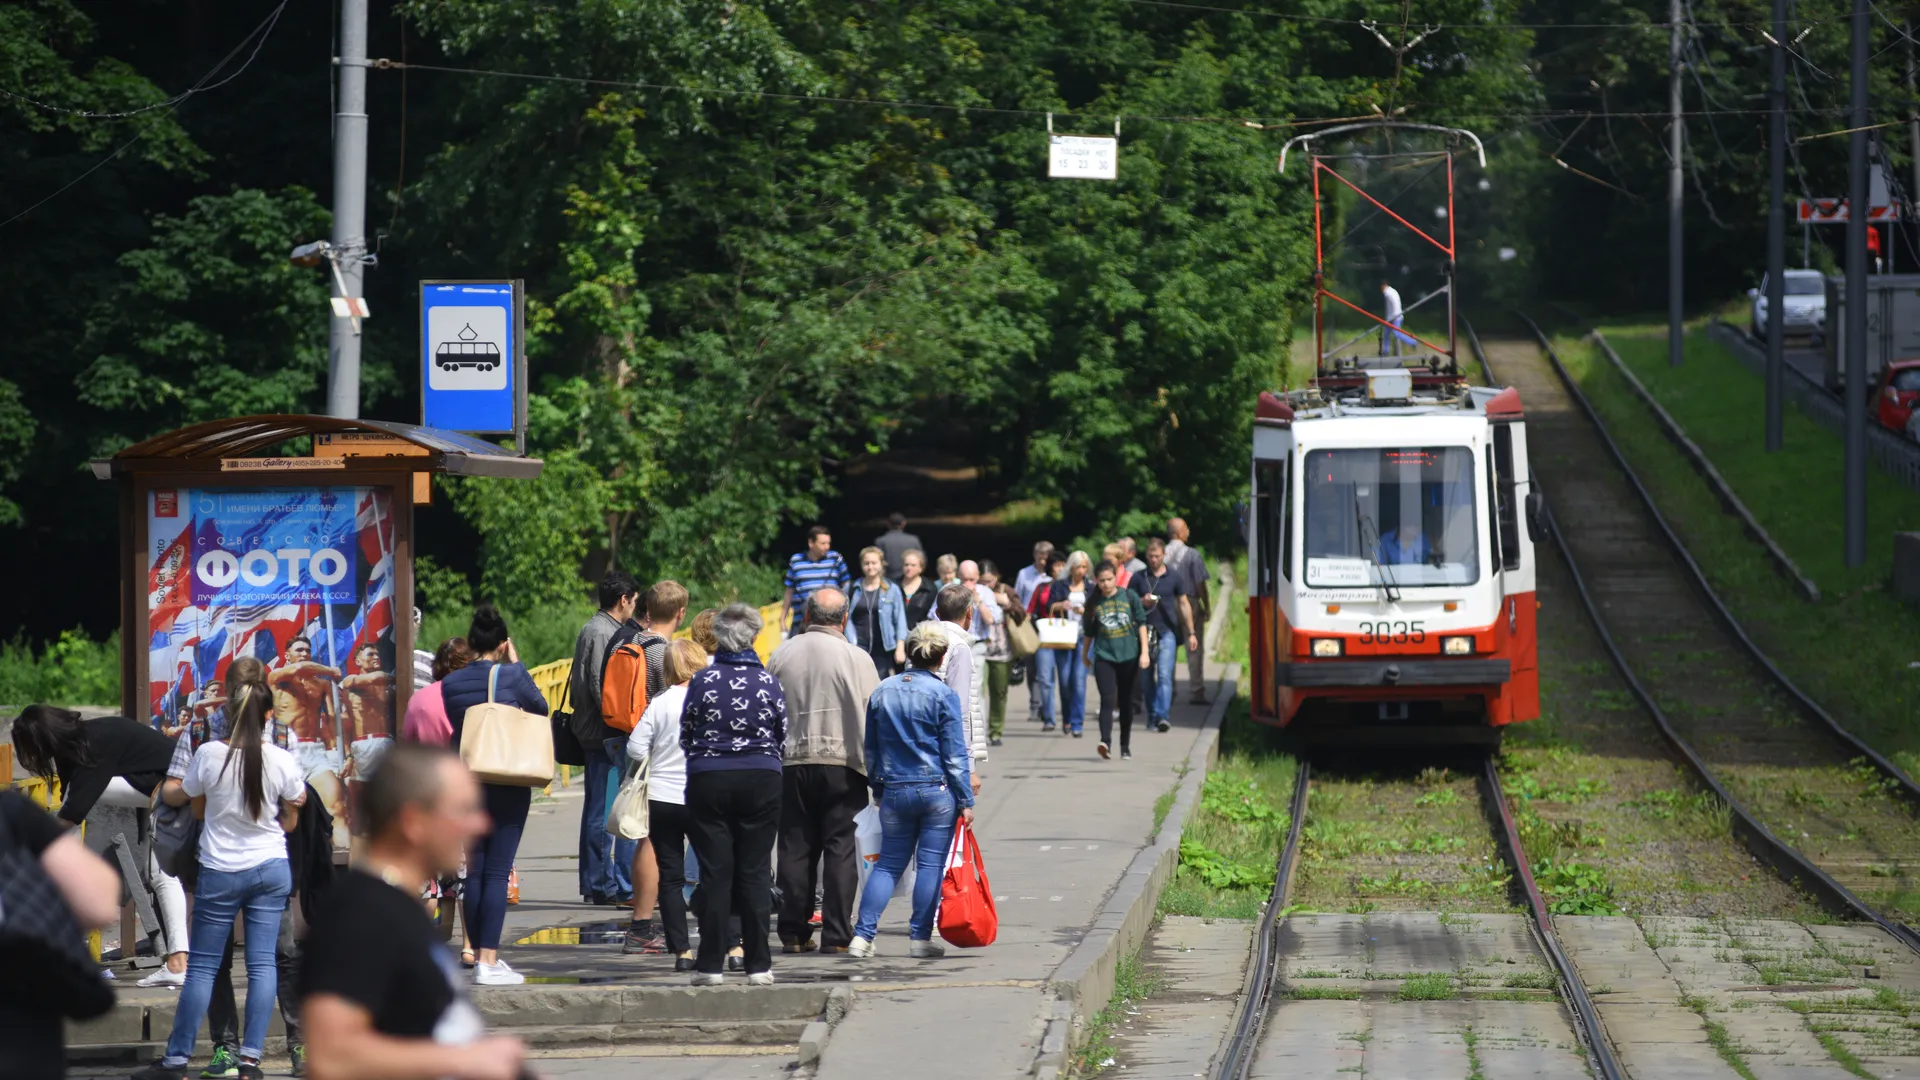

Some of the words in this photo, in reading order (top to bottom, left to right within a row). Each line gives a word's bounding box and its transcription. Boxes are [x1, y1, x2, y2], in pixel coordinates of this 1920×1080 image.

[262, 458, 293, 469] Gallery
[226, 504, 261, 513] ИМЕНИ
[262, 503, 304, 513] БРАТЬЕВ
[305, 503, 346, 513] ЛЮМЬЕР
[197, 535, 346, 546] СОВЕТСКОЕ
[196, 547, 348, 588] ФОТО
[232, 592, 291, 601] ФОТОГРАФИИ
[301, 591, 321, 600] ВЕКА
[328, 590, 351, 600] СССР
[1359, 620, 1426, 645] 3035
